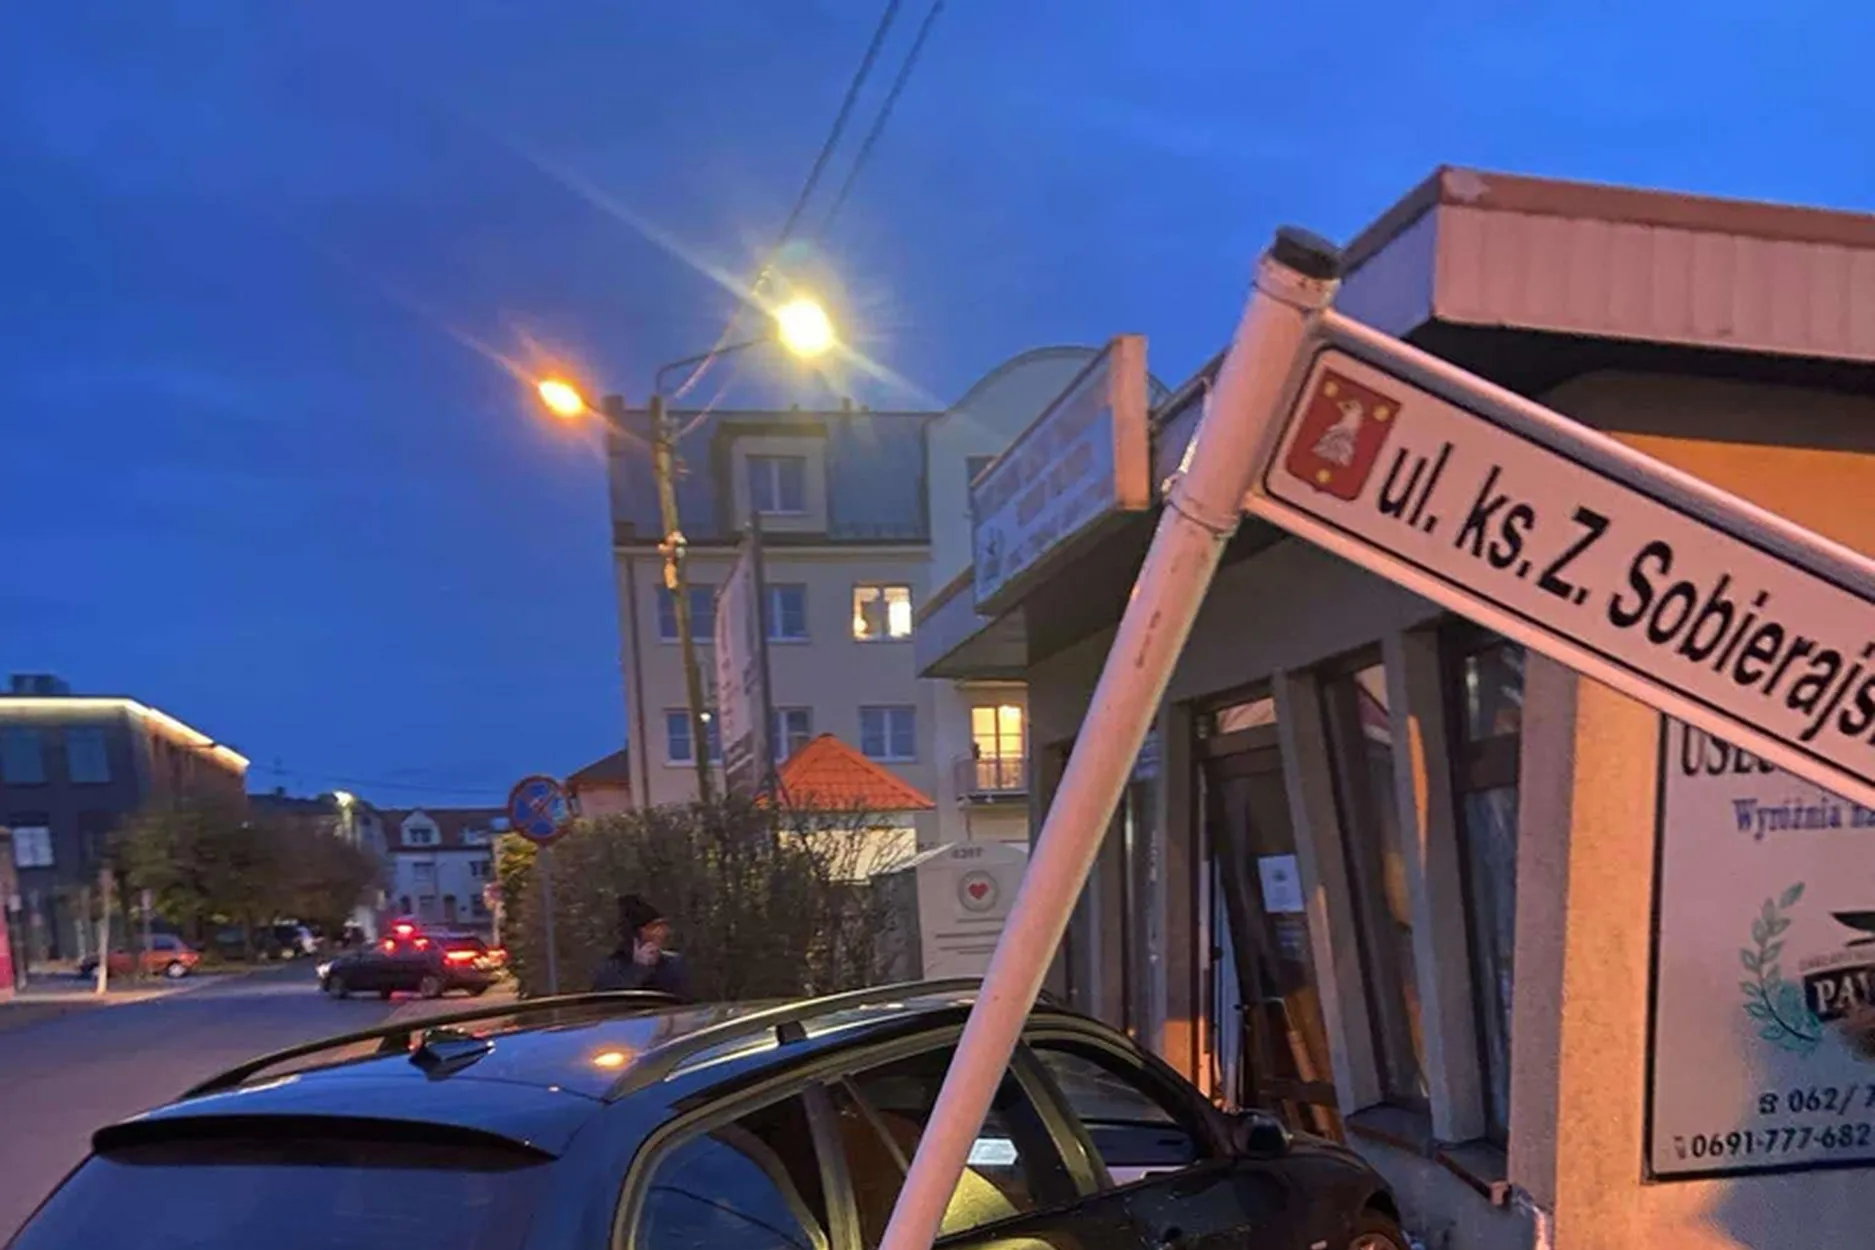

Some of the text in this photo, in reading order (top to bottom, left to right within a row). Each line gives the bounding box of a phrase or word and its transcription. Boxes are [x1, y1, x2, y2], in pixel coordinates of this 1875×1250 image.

[1376, 442, 1454, 534] ul.
[1607, 538, 1875, 746] Sobierajs
[1690, 1122, 1872, 1159] 0691-777-682
